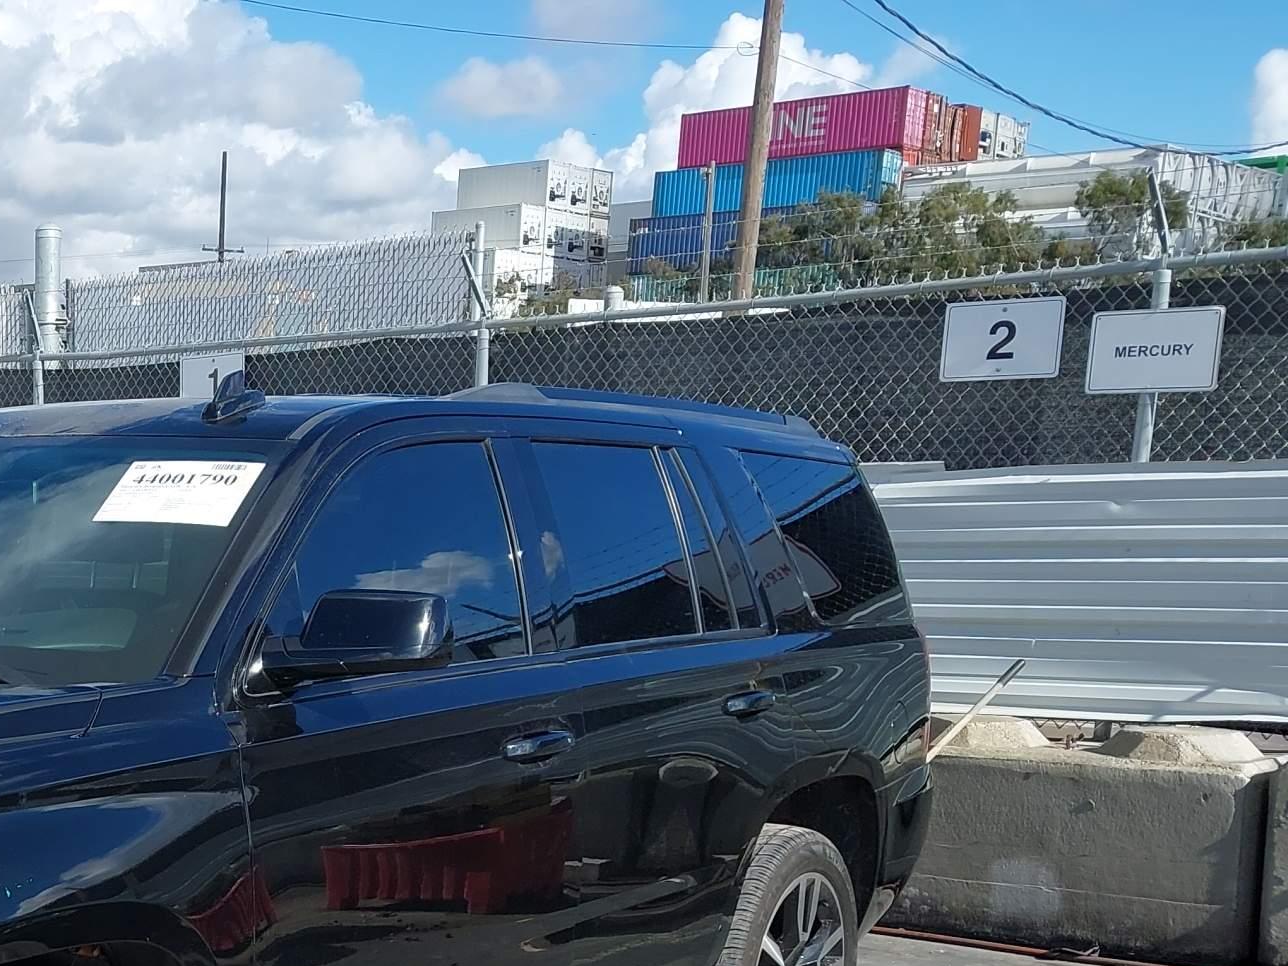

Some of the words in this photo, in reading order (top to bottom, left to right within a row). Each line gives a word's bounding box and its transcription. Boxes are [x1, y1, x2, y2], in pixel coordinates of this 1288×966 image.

[773, 104, 827, 141] NE
[986, 320, 1016, 360] 2
[1114, 343, 1194, 358] MERCURY
[208, 368, 218, 398] 1
[132, 473, 238, 486] 44001790
